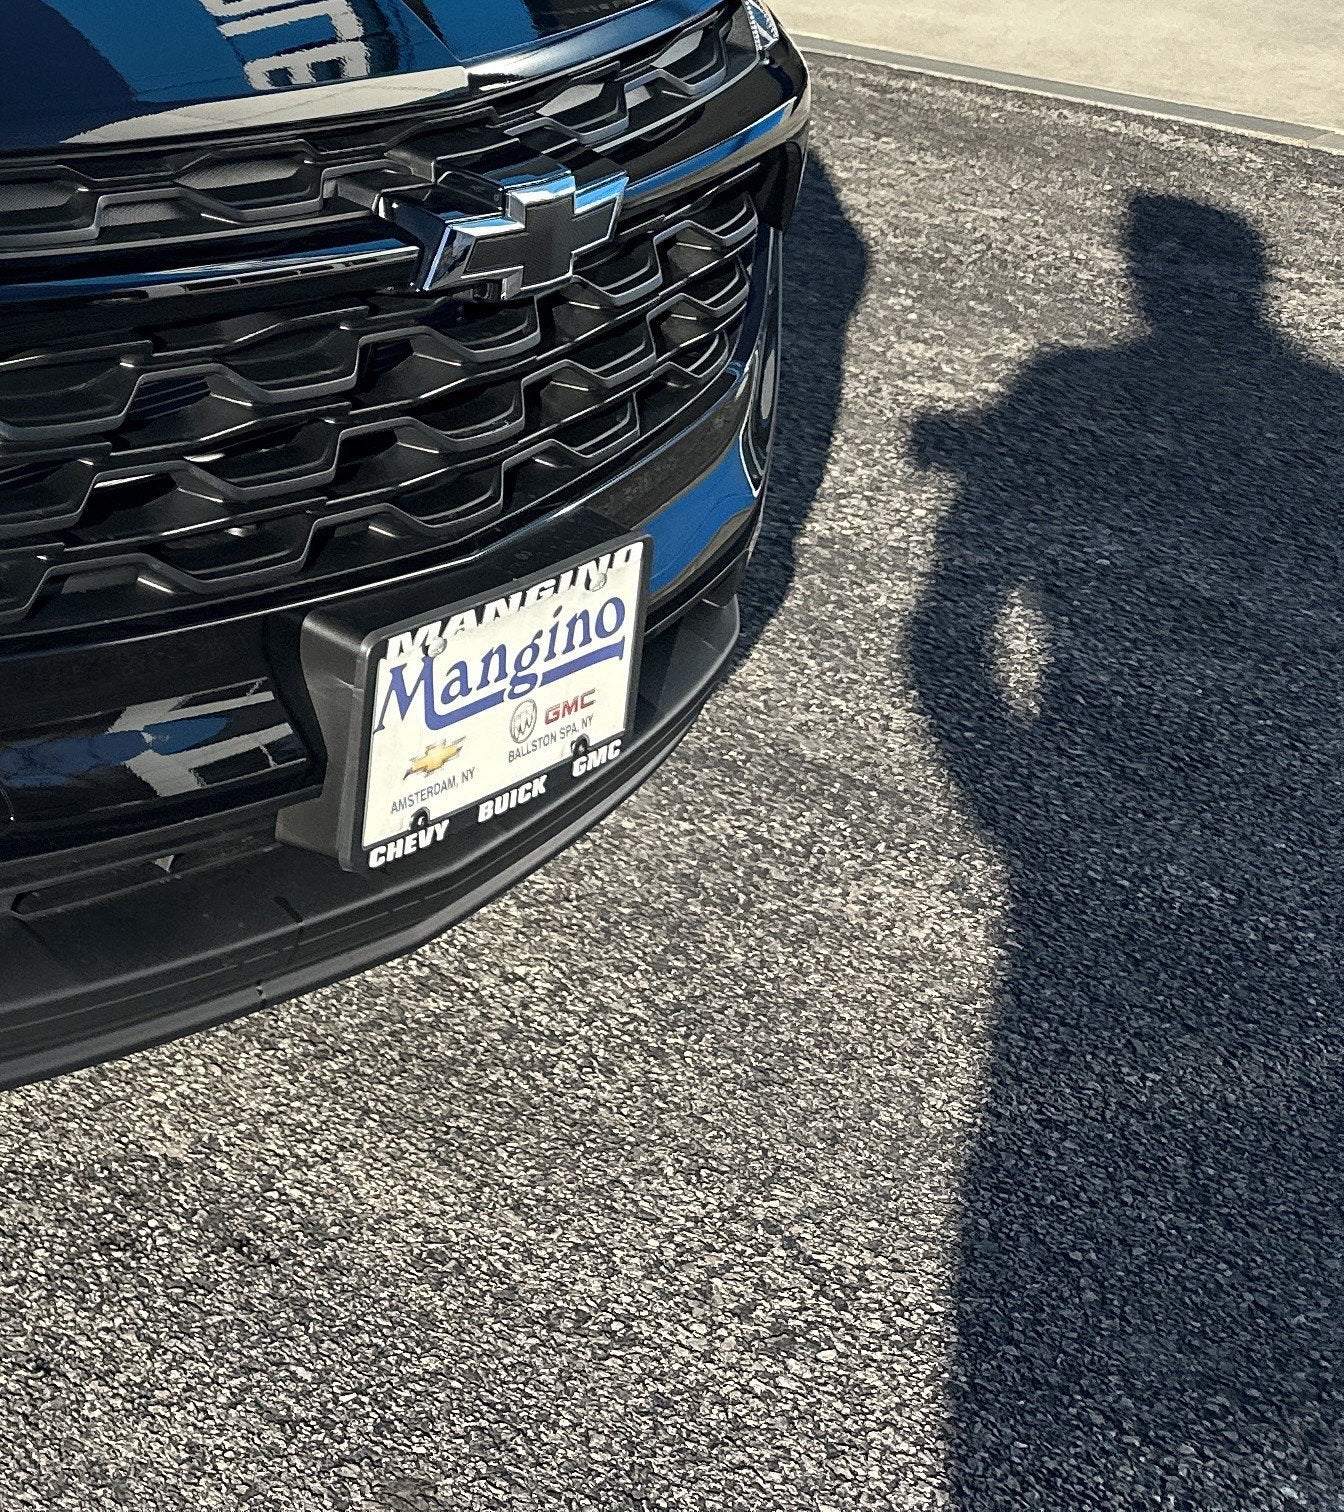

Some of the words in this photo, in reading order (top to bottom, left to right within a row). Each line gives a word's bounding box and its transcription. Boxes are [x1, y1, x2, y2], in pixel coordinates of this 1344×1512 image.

[386, 542, 644, 660] MANGINO
[373, 597, 626, 733] Mangino
[544, 688, 597, 725] GMC
[508, 729, 558, 764] BALLSTON
[559, 722, 580, 740] SPA,
[581, 715, 595, 732] NY
[369, 819, 450, 869] CHEVY
[477, 774, 548, 823] BUICK
[572, 739, 622, 778] GMC
[391, 775, 459, 814] AMSTERDAM,
[461, 767, 476, 784] NY
